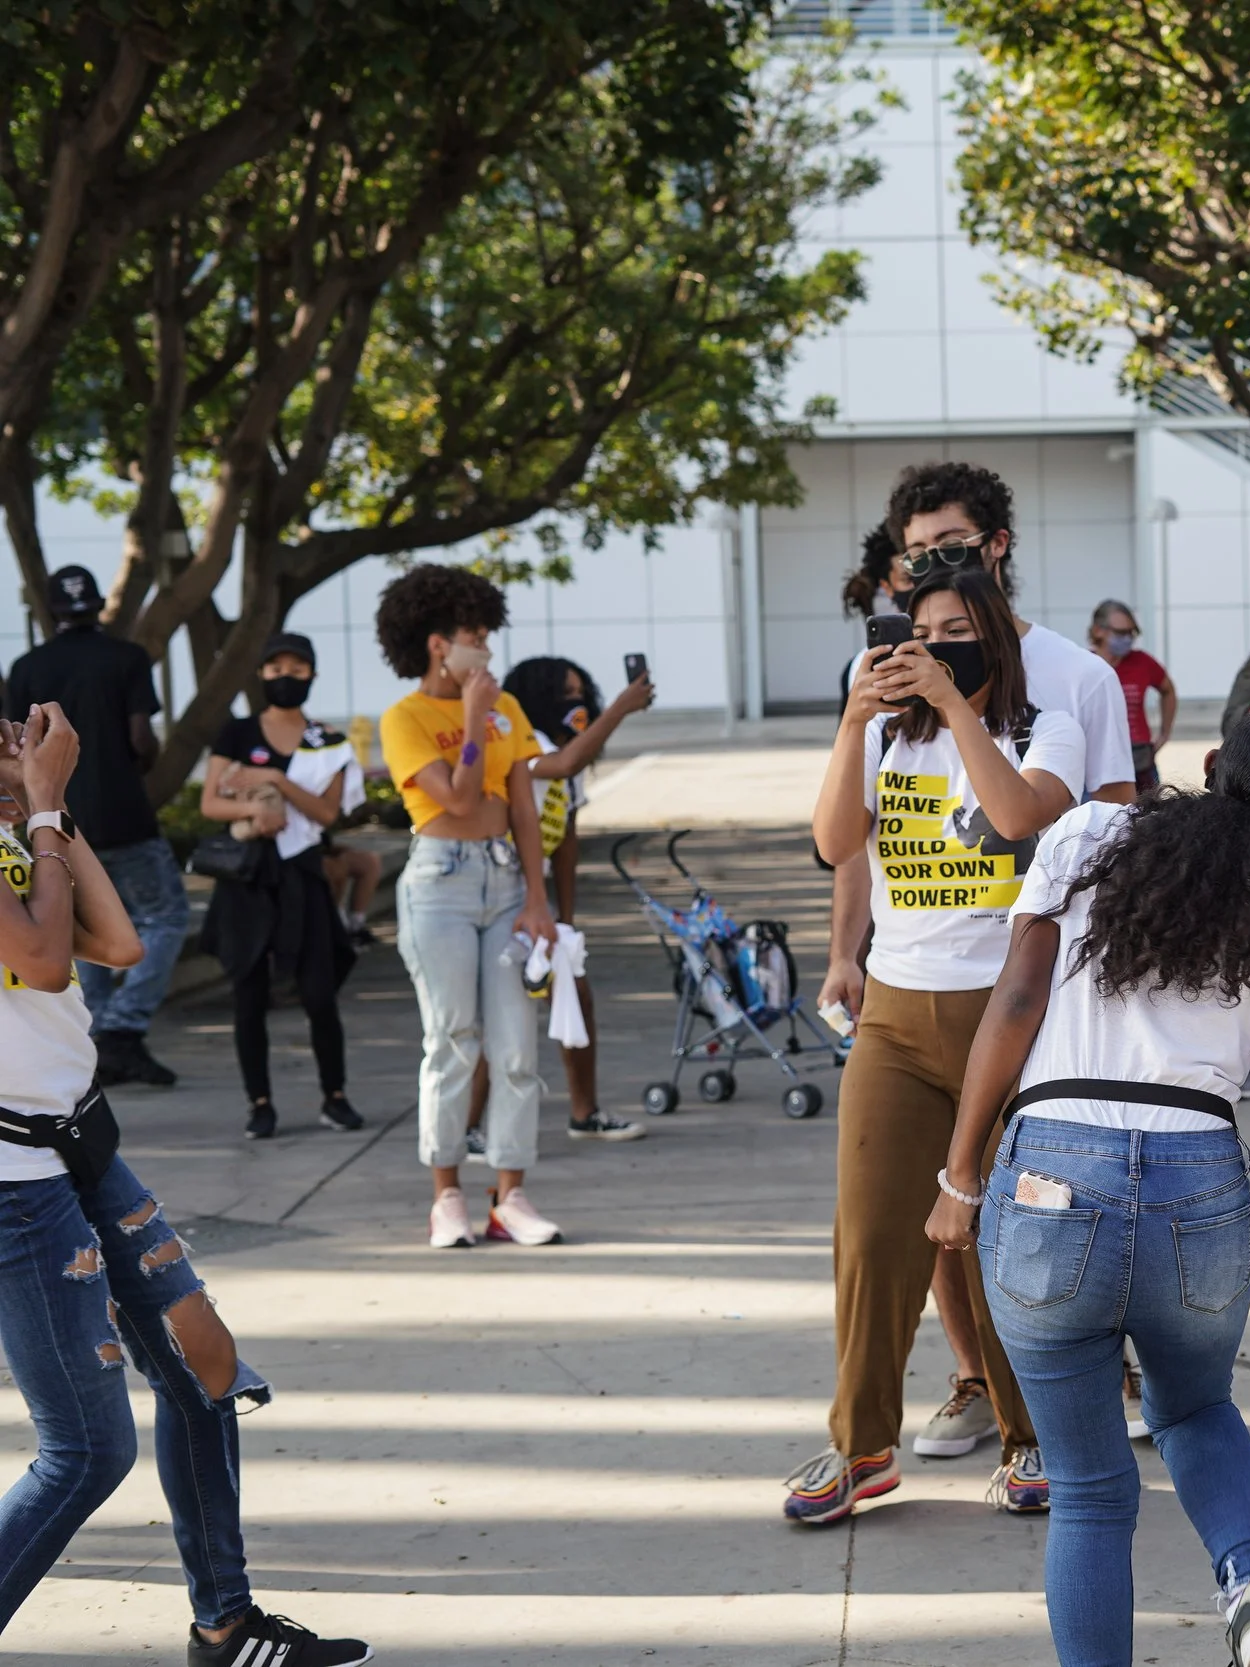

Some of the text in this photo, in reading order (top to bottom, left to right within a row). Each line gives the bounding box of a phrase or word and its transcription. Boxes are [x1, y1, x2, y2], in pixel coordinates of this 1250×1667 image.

[882, 795, 941, 814] HAVE
[879, 818, 903, 835] TO
[879, 840, 946, 858] BUILD
[886, 860, 995, 879] OUR OWN
[891, 886, 989, 907] POWER!"
